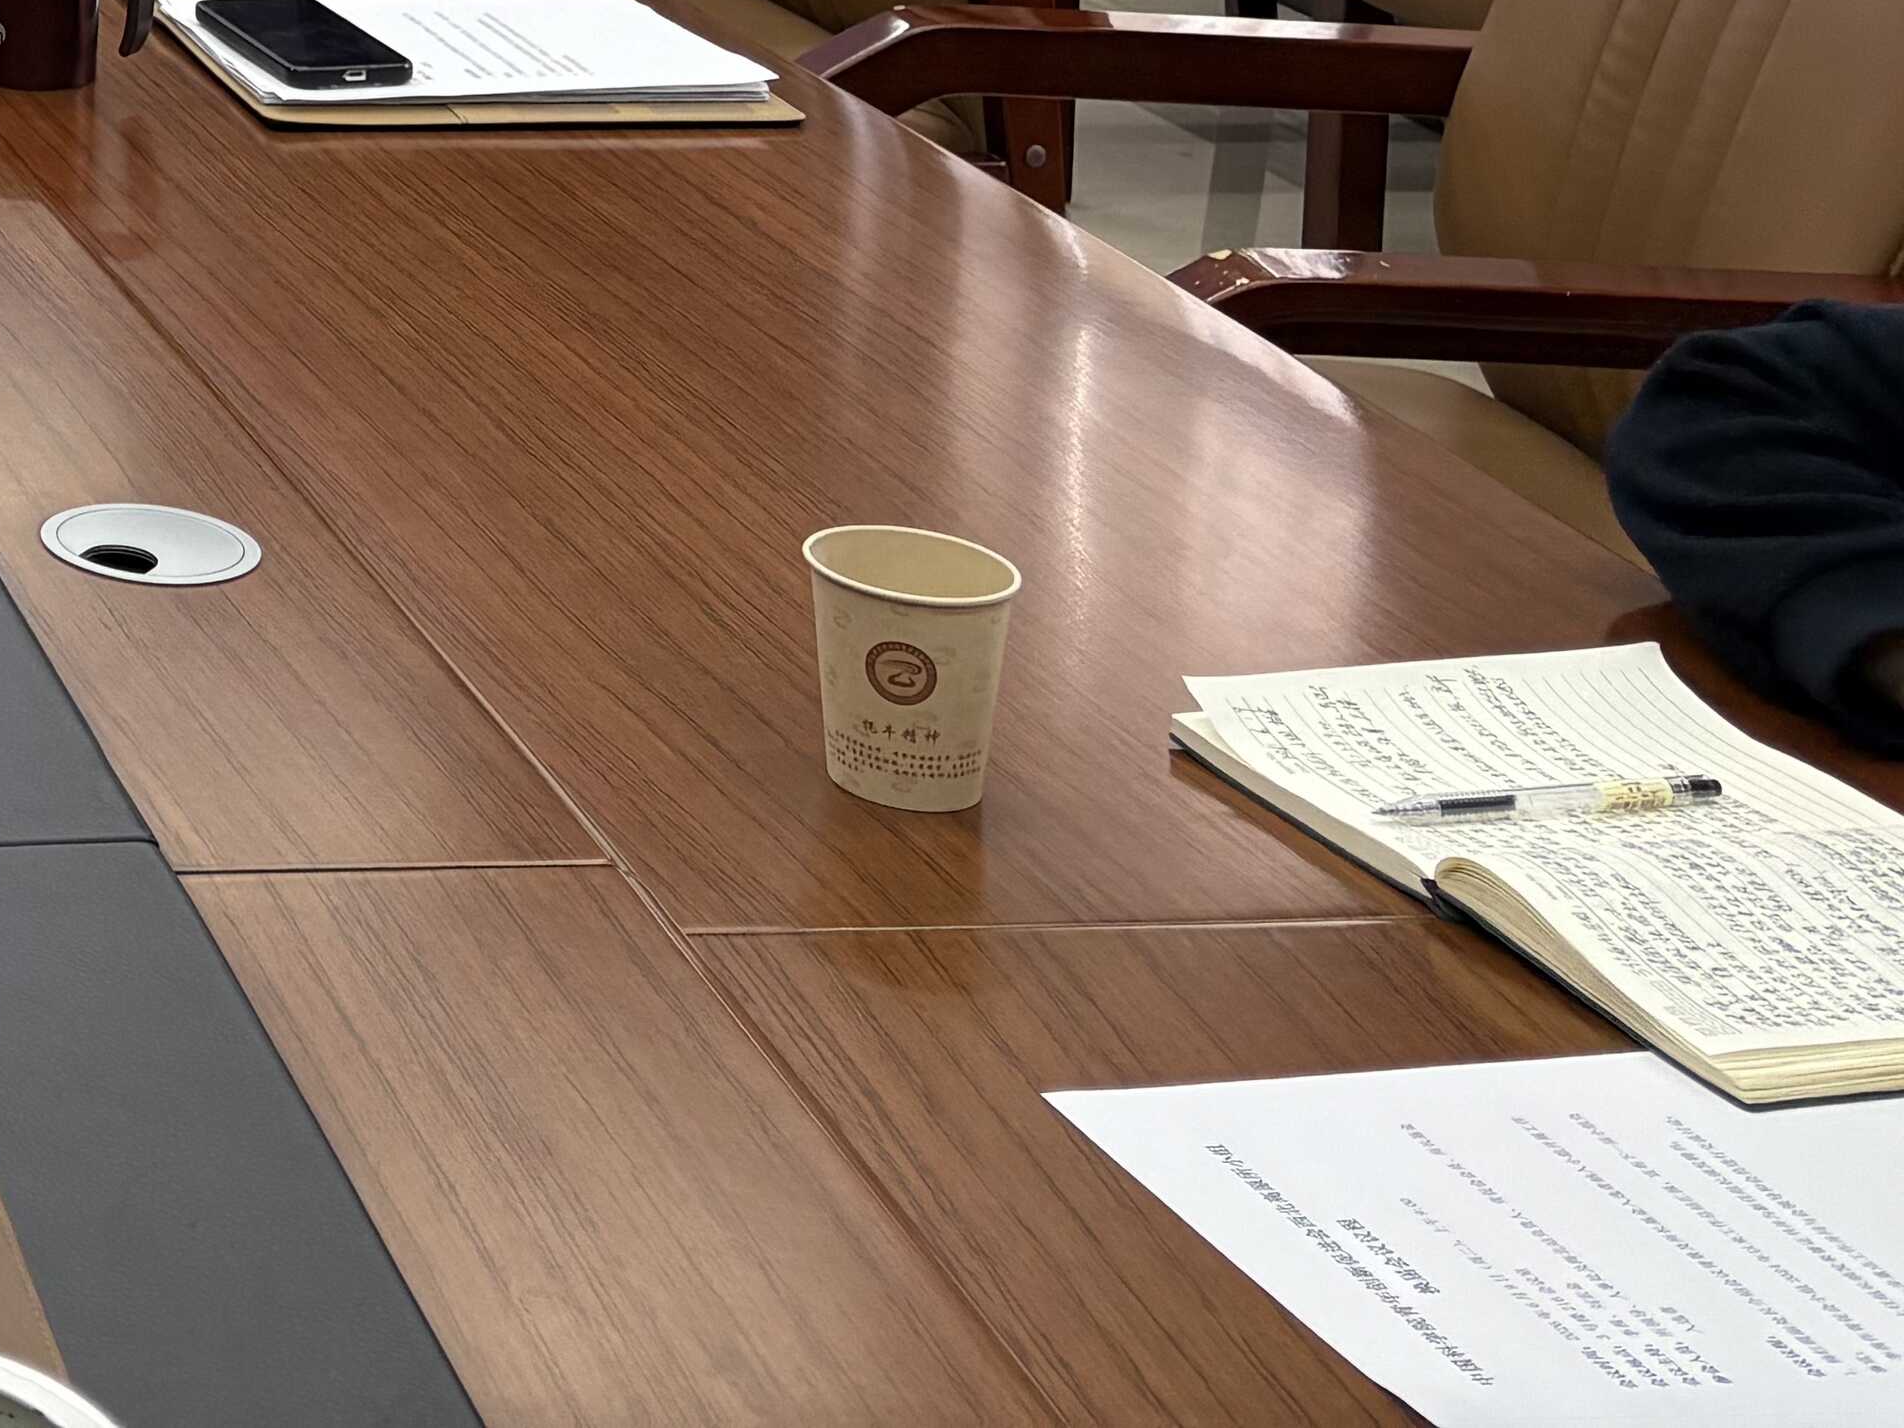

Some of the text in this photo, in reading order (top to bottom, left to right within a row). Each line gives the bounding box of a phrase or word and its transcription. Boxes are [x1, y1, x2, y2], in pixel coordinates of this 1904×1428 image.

[1205, 1143, 1494, 1386] 中国科学院青年创新促进会西北高原所小组
[1337, 1218, 1441, 1295] 换届会议议程
